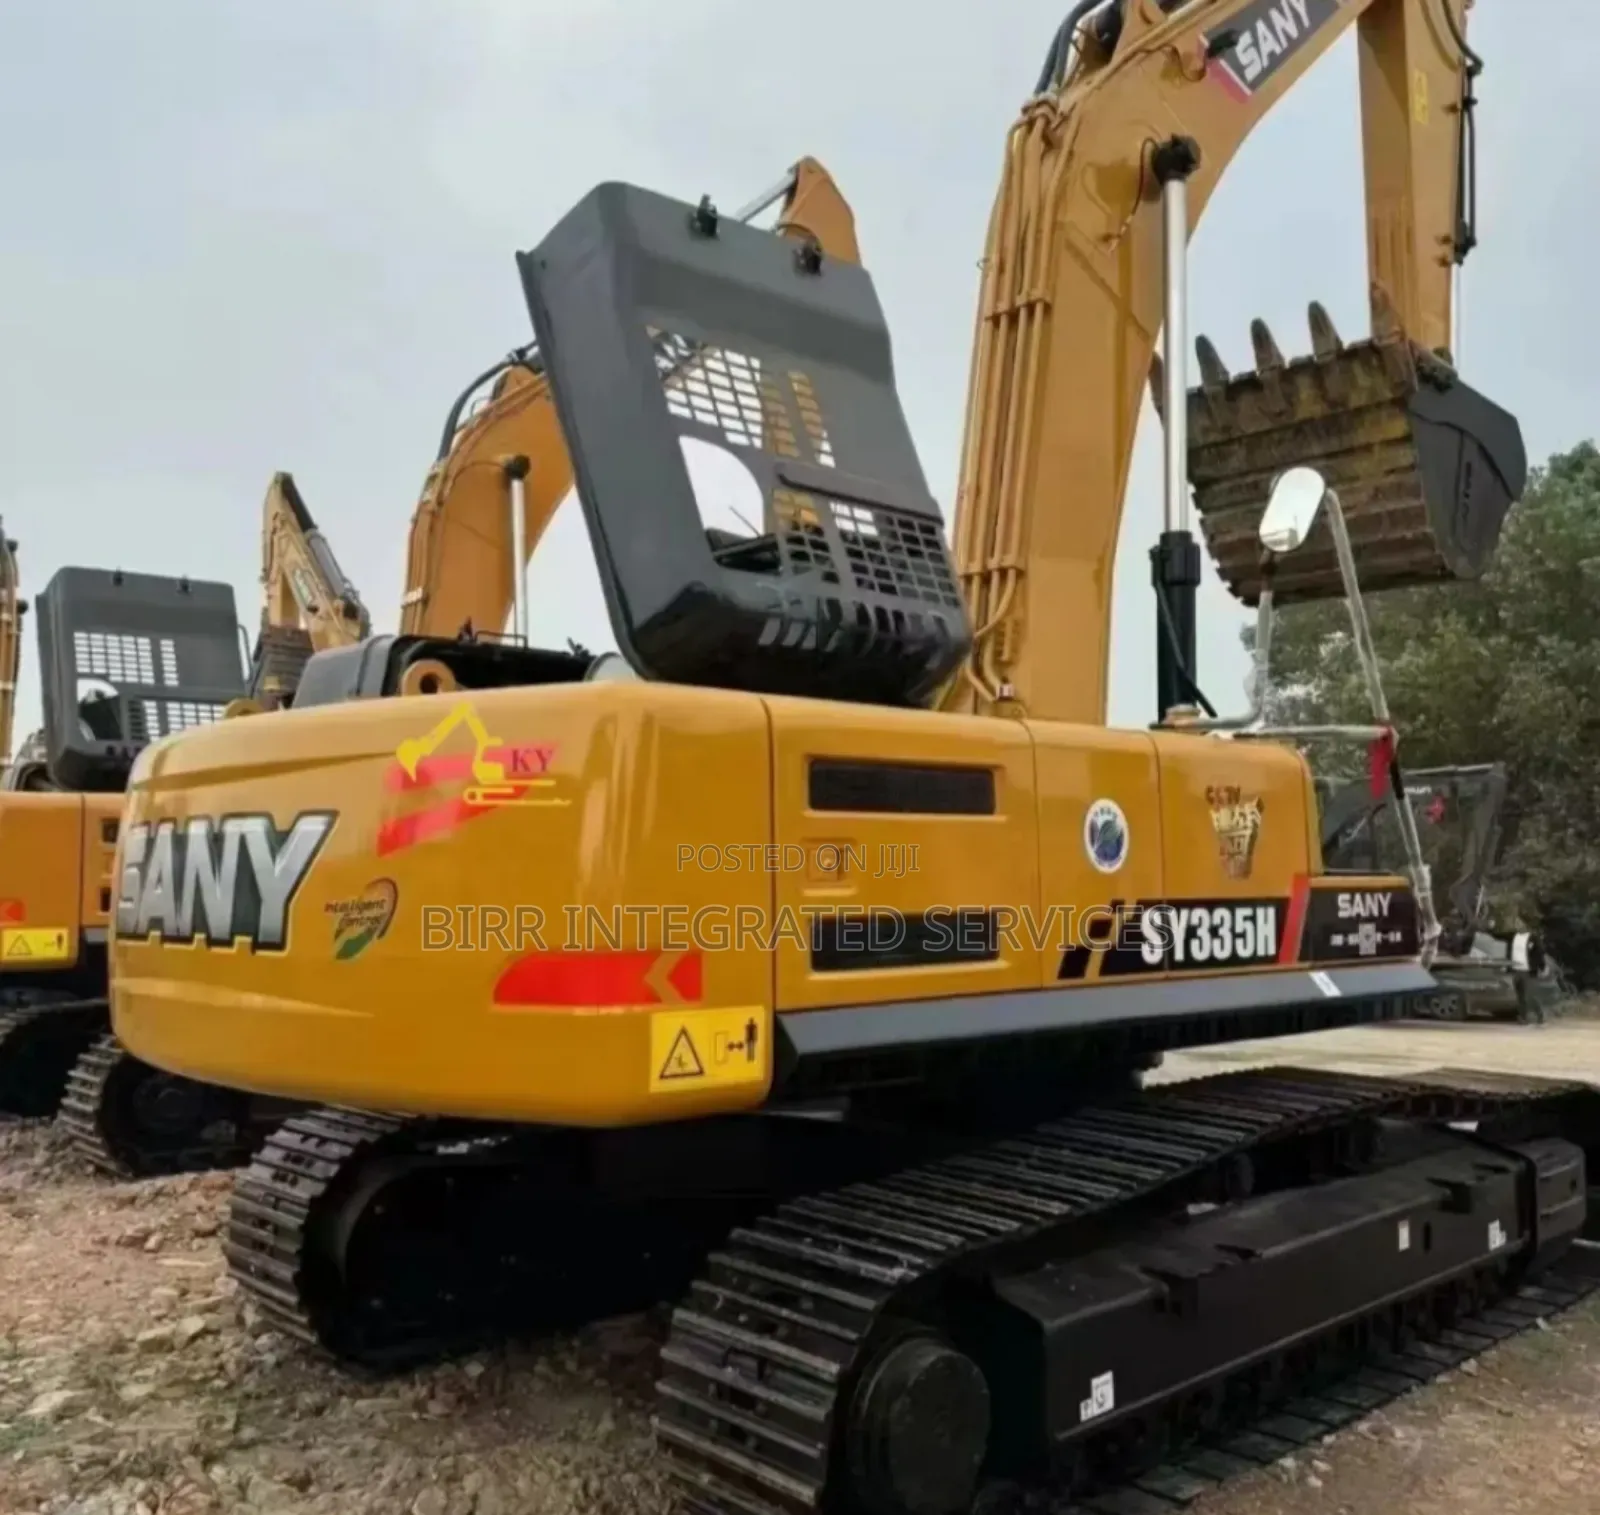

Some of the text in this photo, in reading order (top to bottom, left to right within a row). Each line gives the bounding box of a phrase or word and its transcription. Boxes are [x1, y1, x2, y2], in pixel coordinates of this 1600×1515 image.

[1235, 0, 1310, 83] SANY
[511, 747, 553, 773] KY
[115, 811, 337, 952] SANY
[1337, 891, 1392, 919] SANY
[1140, 905, 1277, 965] SY335H
